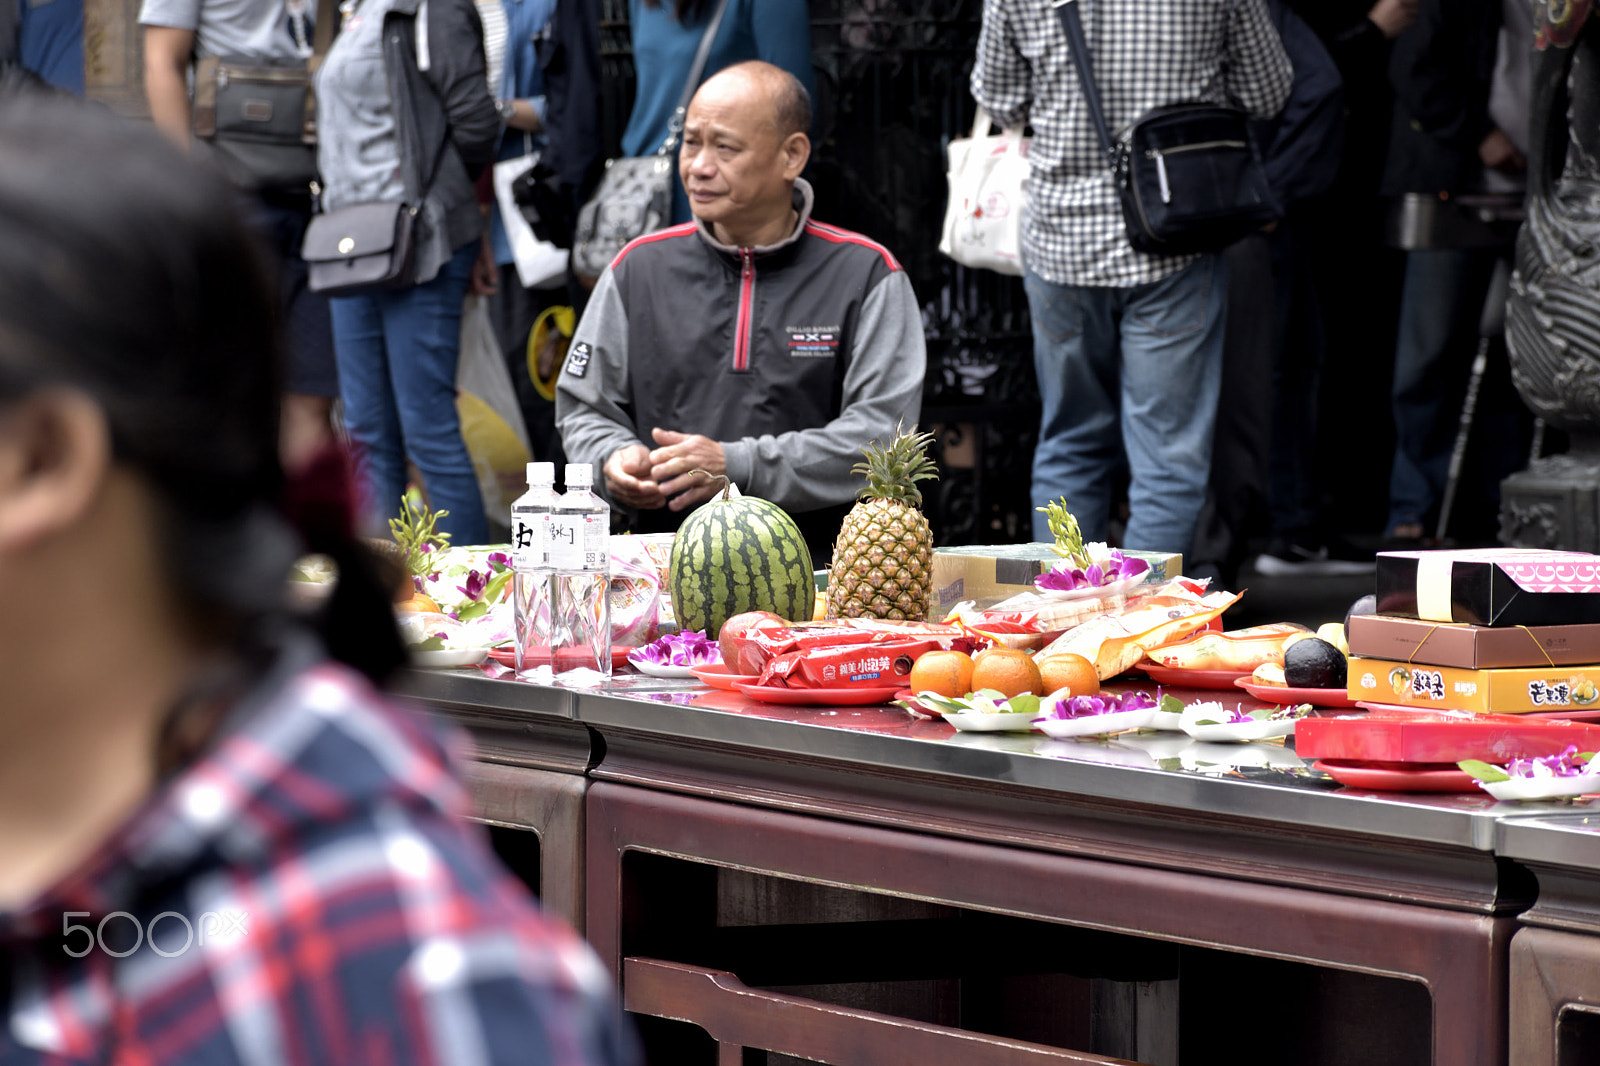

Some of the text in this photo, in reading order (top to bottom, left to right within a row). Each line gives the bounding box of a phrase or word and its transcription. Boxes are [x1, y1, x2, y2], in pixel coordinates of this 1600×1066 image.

[857, 656, 891, 674] 小泡芙
[1412, 671, 1444, 698] 芒果凍
[1530, 681, 1570, 704] 芒果凍
